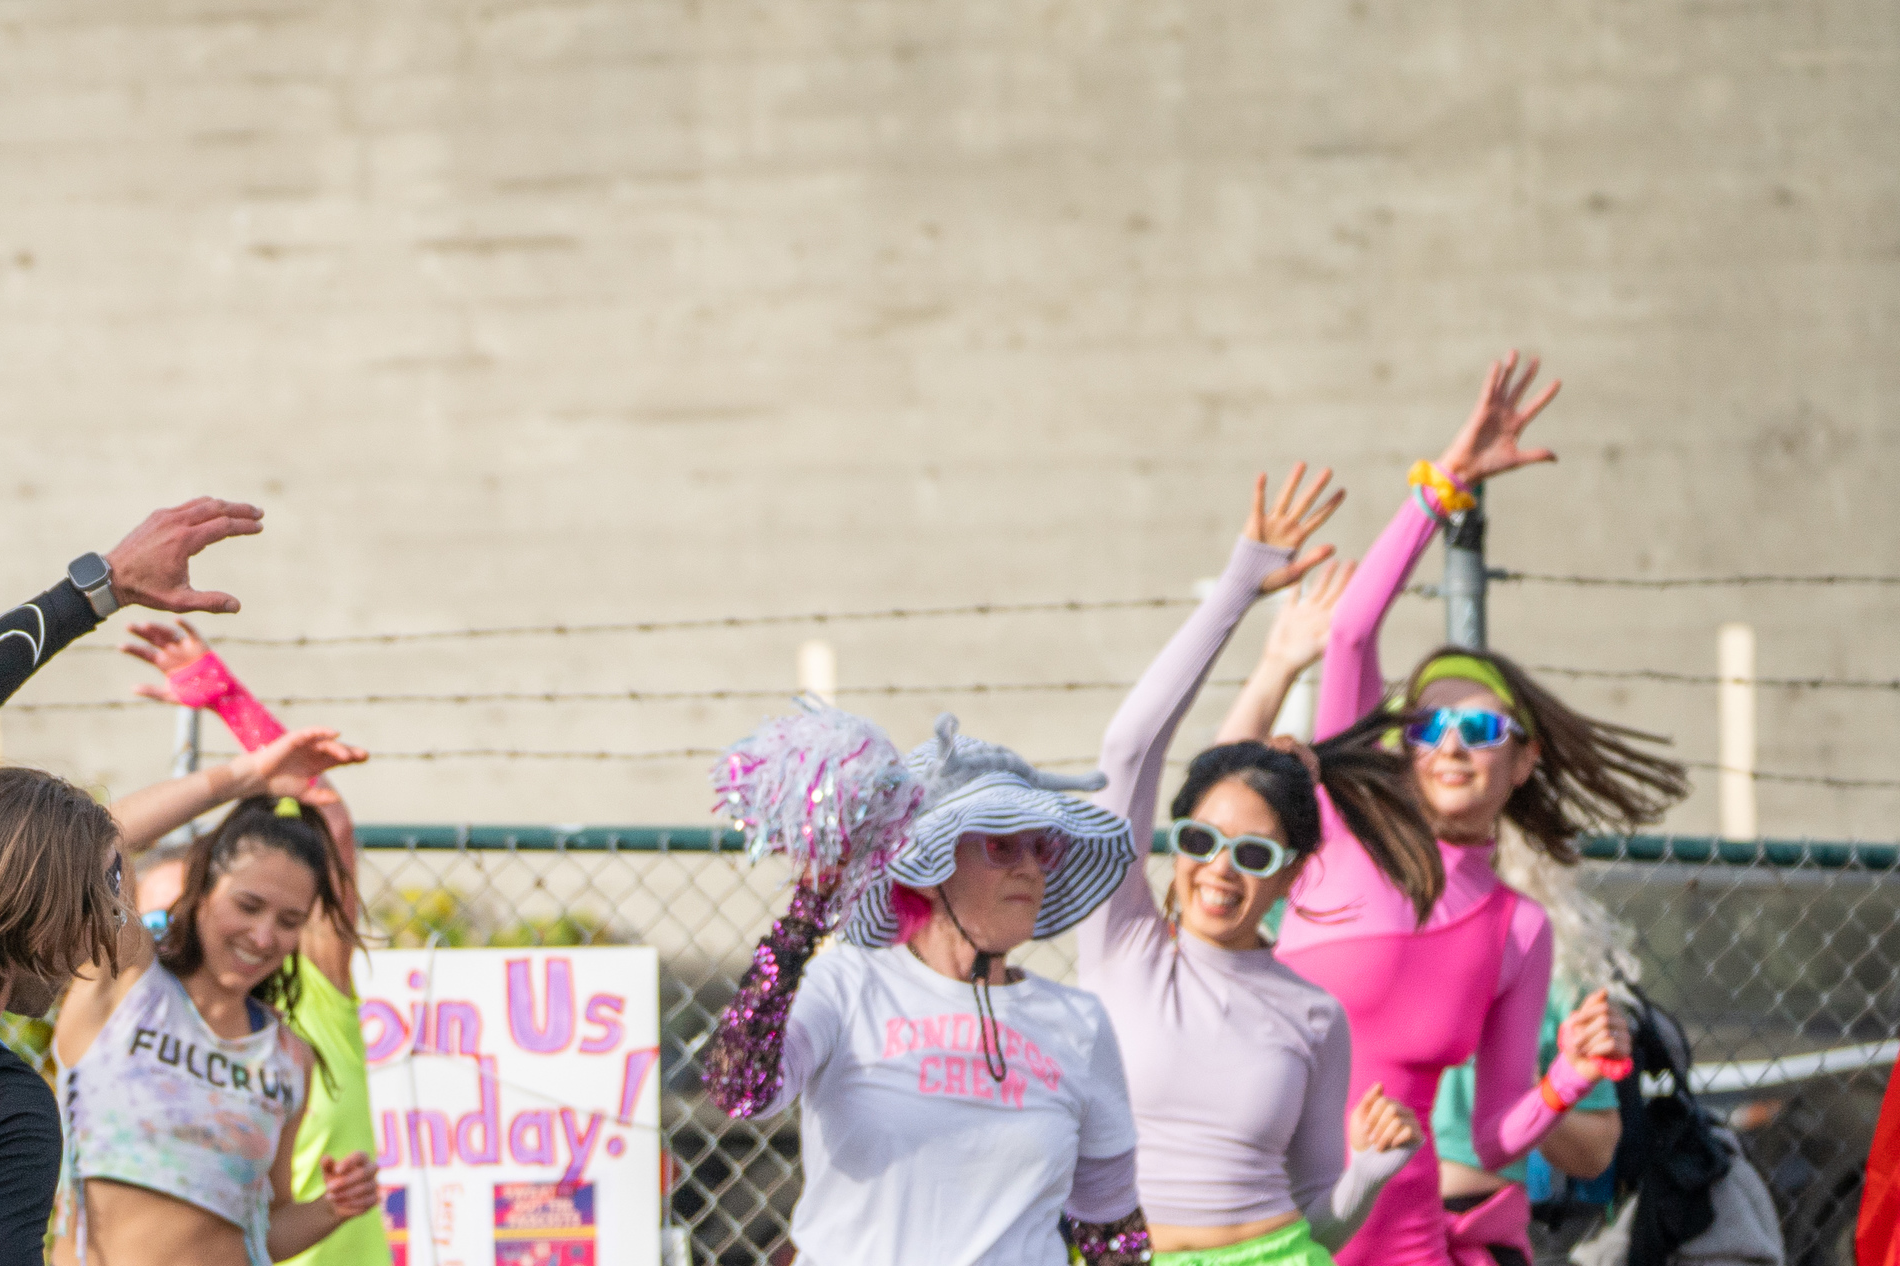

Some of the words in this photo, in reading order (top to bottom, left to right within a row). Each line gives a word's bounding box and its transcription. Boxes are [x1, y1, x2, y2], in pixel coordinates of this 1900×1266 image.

[358, 969, 483, 1064] oin
[504, 956, 627, 1057] Us
[376, 1046, 660, 1197] unday!
[918, 1055, 1028, 1110] CREW
